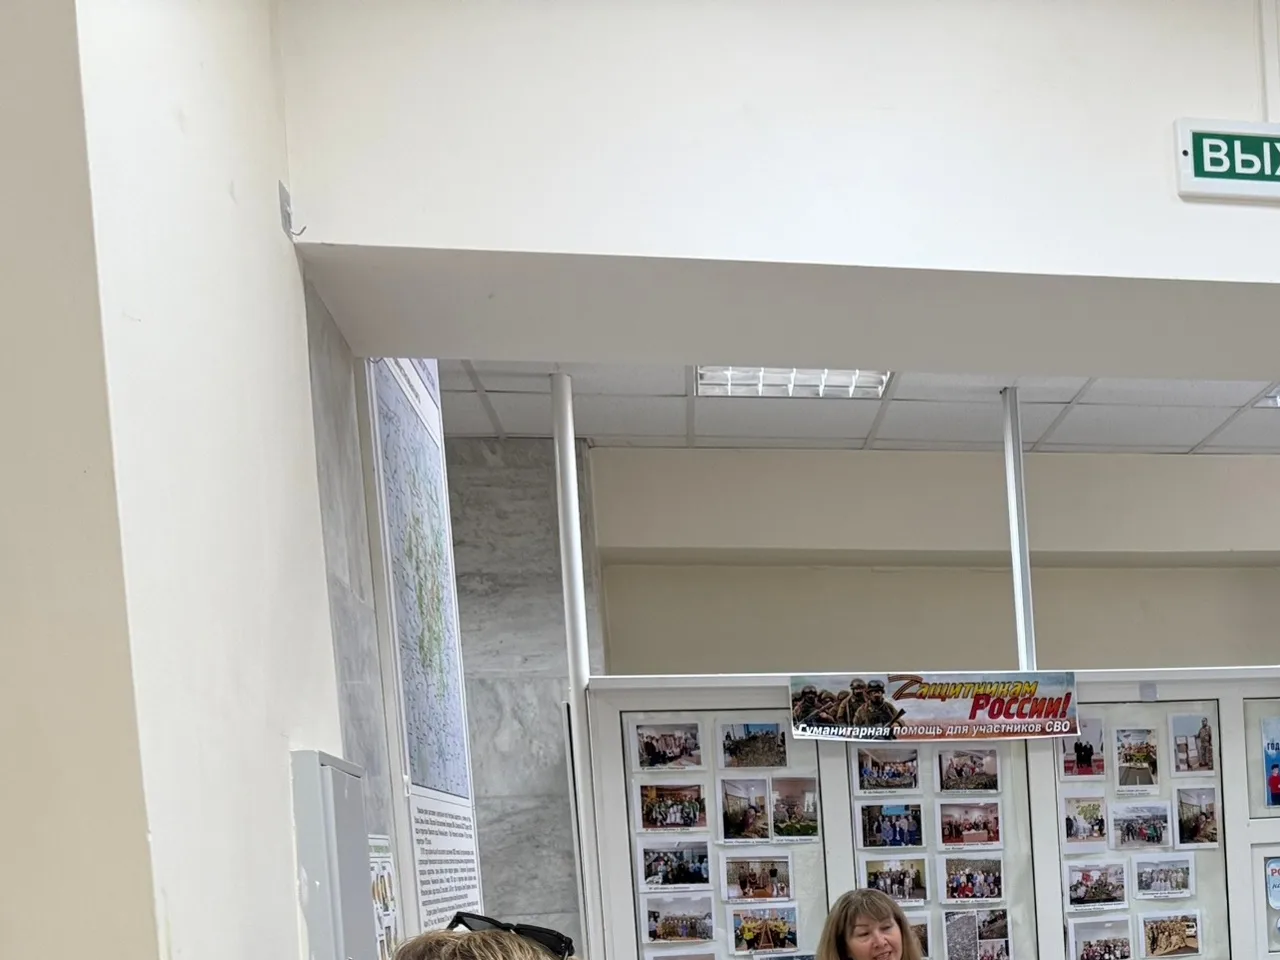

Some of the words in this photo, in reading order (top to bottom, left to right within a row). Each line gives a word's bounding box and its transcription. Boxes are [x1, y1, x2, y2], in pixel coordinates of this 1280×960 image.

[799, 723, 890, 737] Гуманитарная
[893, 723, 942, 737] помощь
[946, 724, 968, 736] для
[971, 723, 1041, 735] участников
[1045, 720, 1070, 732] СВО
[1267, 742, 1280, 751] ГОД
